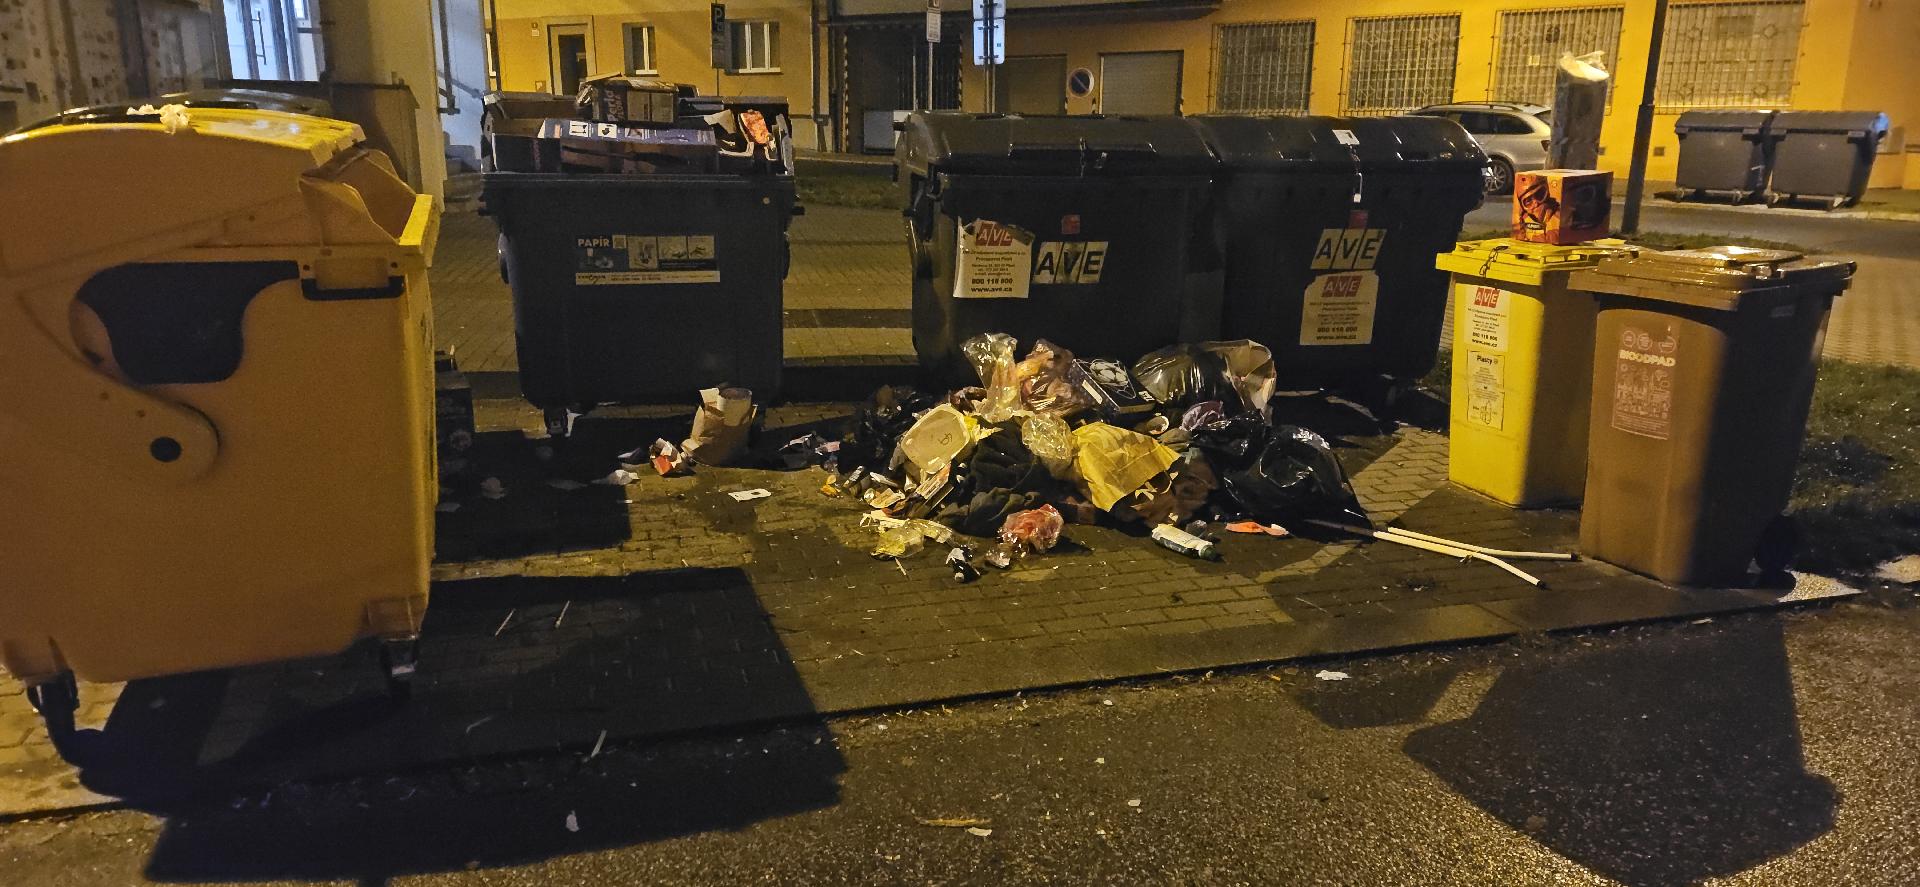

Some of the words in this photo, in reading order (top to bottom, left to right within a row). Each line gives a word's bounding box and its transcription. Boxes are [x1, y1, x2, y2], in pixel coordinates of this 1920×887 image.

[714, 7, 723, 24] P
[577, 236, 610, 247] PAPÍR
[978, 228, 1012, 241] AVE
[1316, 238, 1379, 259] AVE
[1034, 251, 1104, 275] AVE
[1325, 280, 1359, 292] AVE
[1476, 290, 1498, 305] AVE
